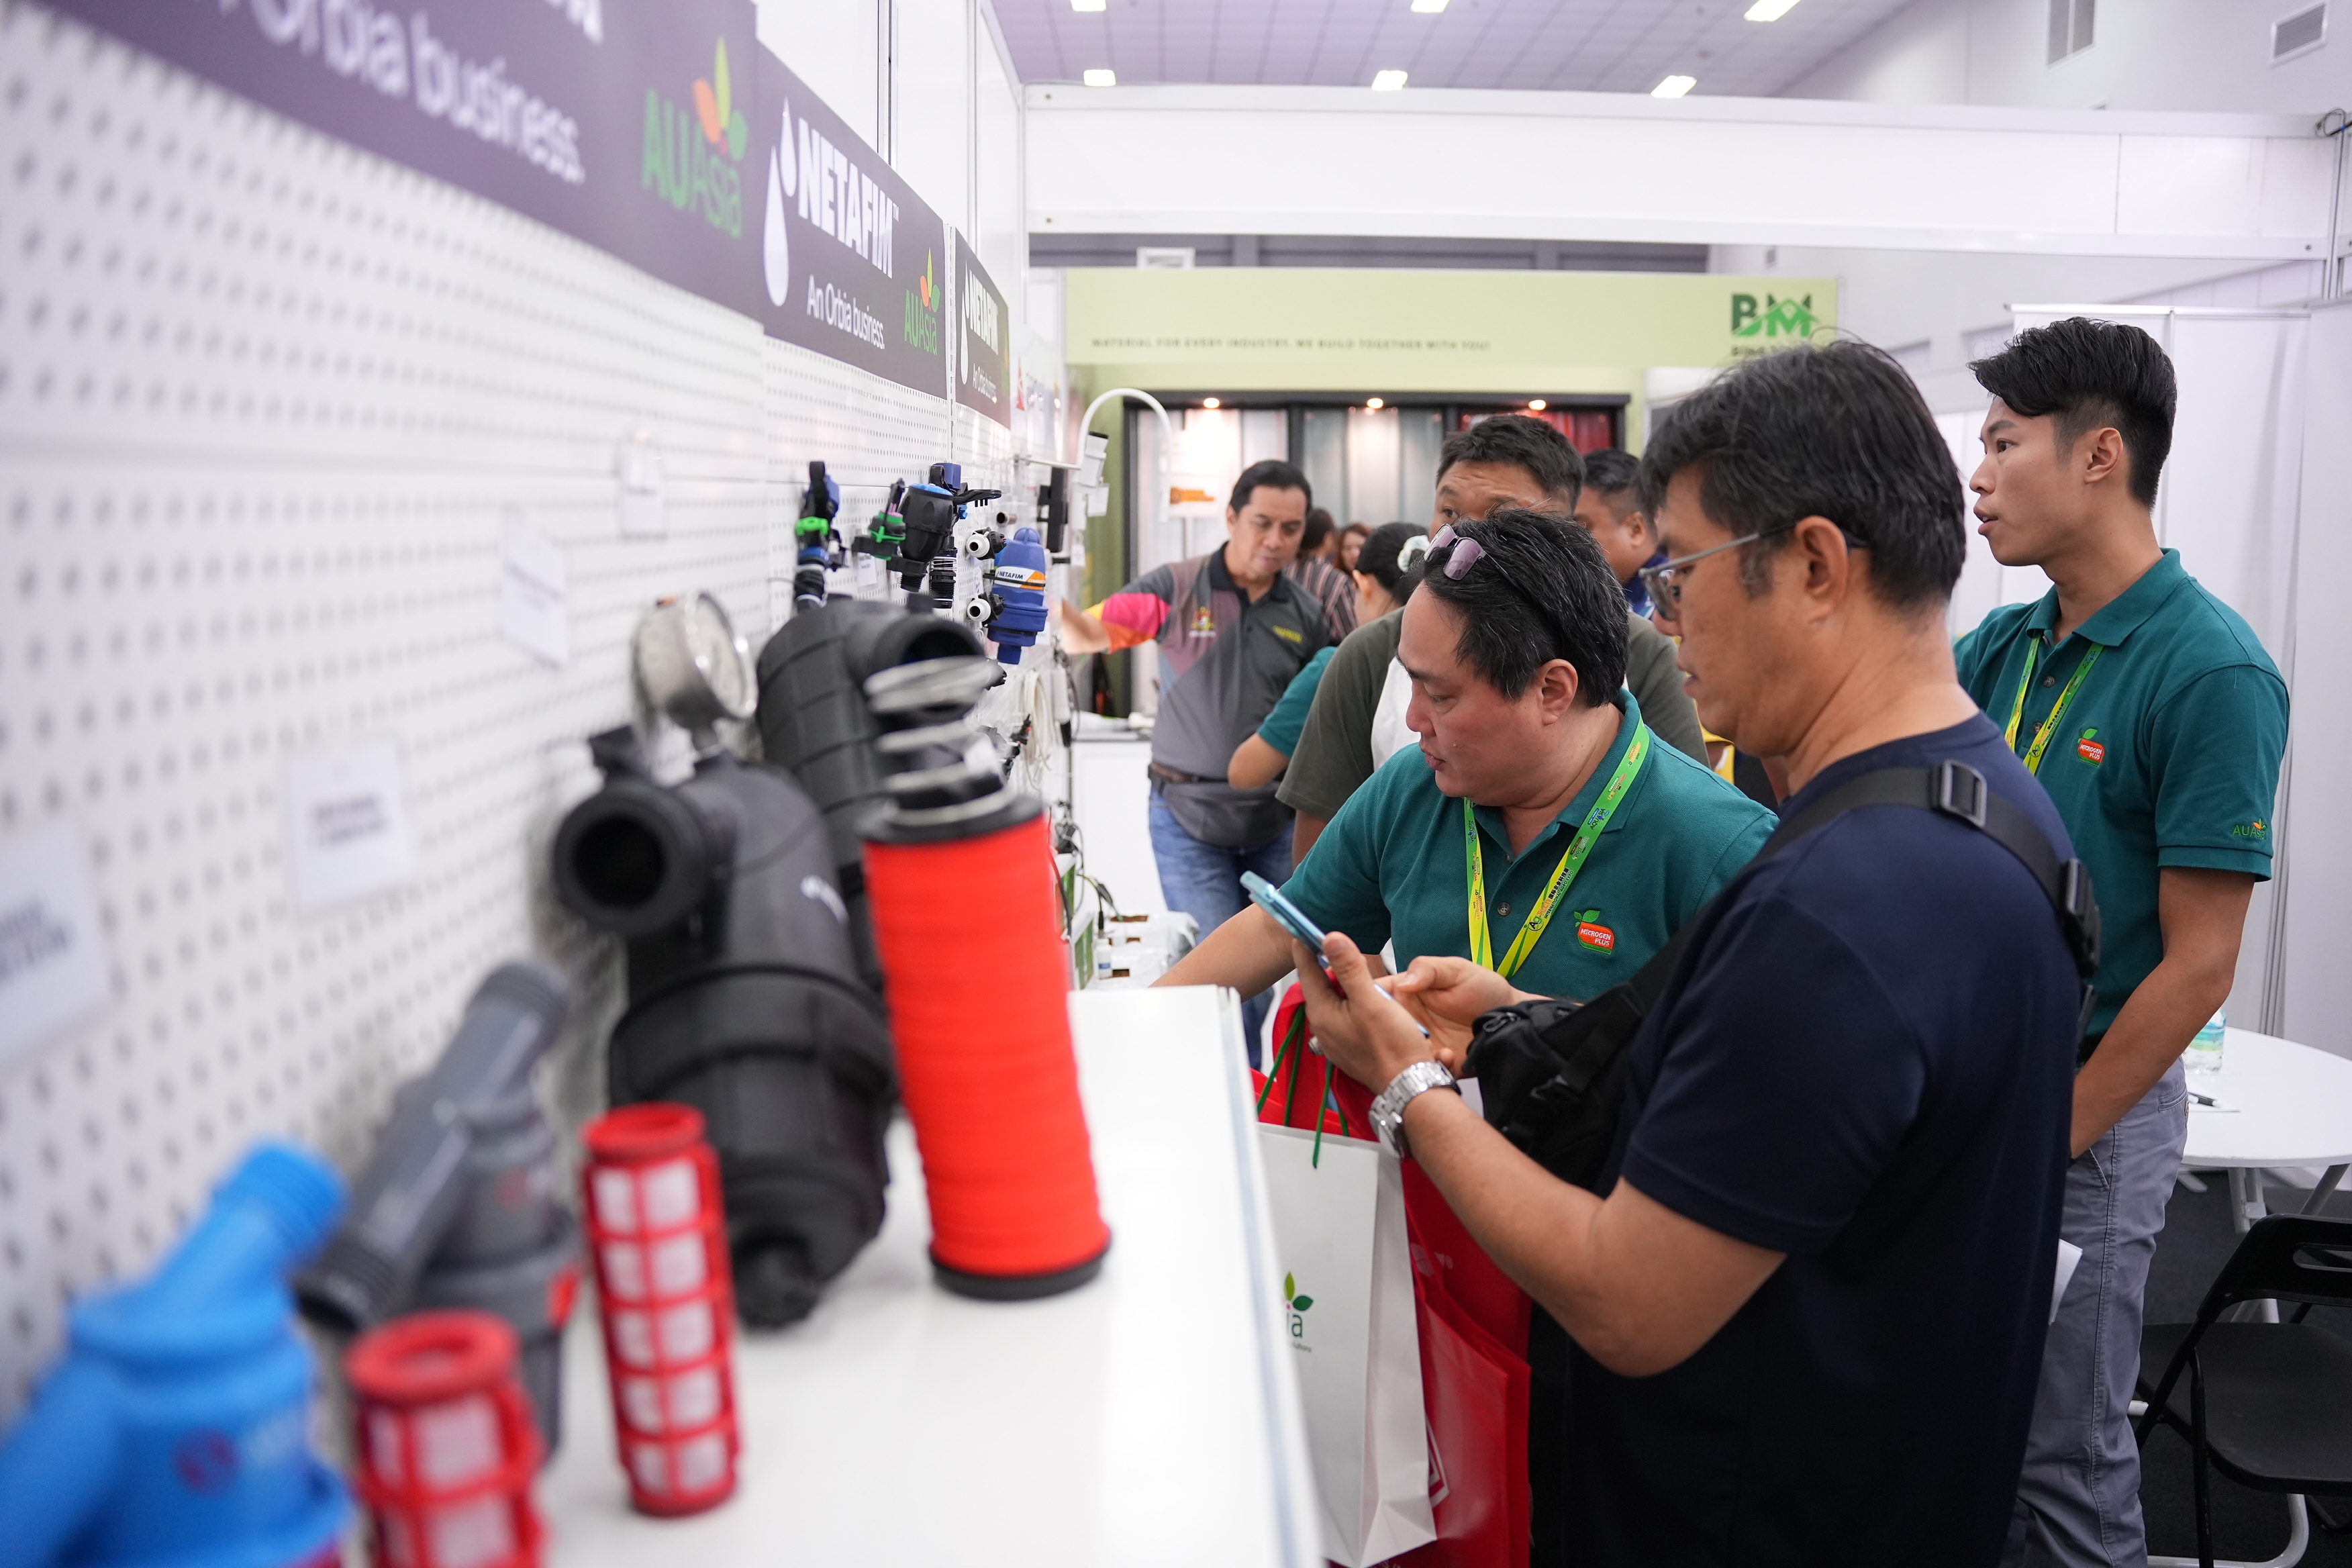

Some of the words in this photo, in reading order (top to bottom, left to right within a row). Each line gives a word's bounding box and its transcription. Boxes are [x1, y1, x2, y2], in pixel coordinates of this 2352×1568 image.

[807, 274, 824, 321] An
[825, 283, 852, 334] Orbia
[852, 297, 885, 350] business.
[905, 289, 938, 356] AUAsia
[999, 570, 1024, 580] NETAFIM
[2080, 744, 2102, 754] MICROGEN
[1543, 891, 1561, 919] INTERNATIONAL
[1580, 928, 1612, 940] MICROGEN
[1594, 938, 1610, 946] PLUS
